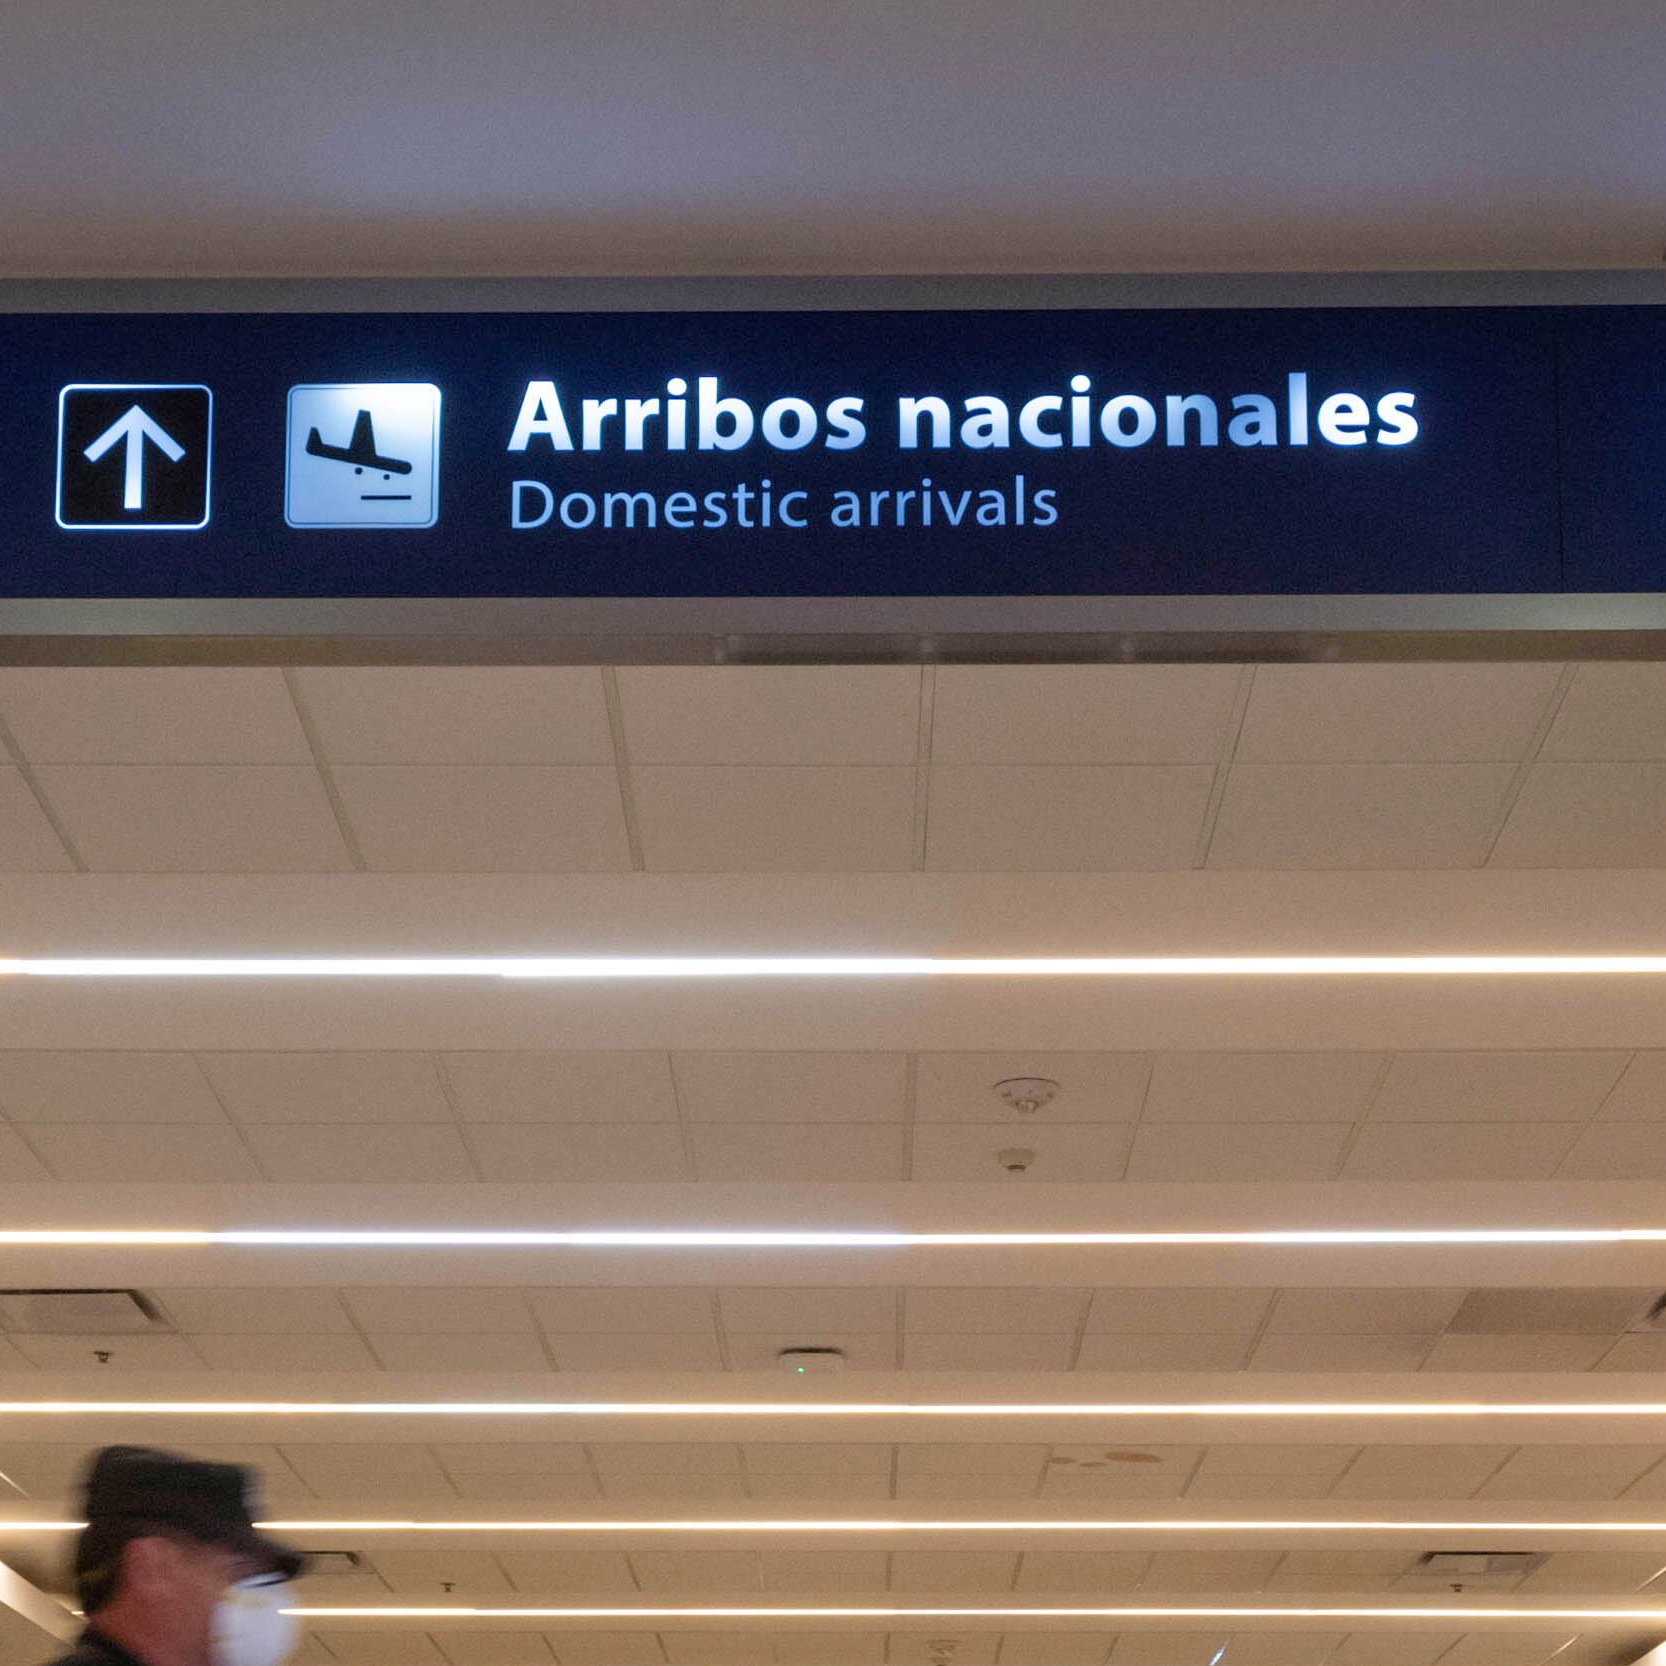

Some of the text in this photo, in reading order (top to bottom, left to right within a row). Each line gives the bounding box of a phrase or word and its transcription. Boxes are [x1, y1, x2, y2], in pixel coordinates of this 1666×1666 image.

[507, 371, 1419, 453] Arribos nacionales
[510, 474, 1060, 530] Domestic arrivals
